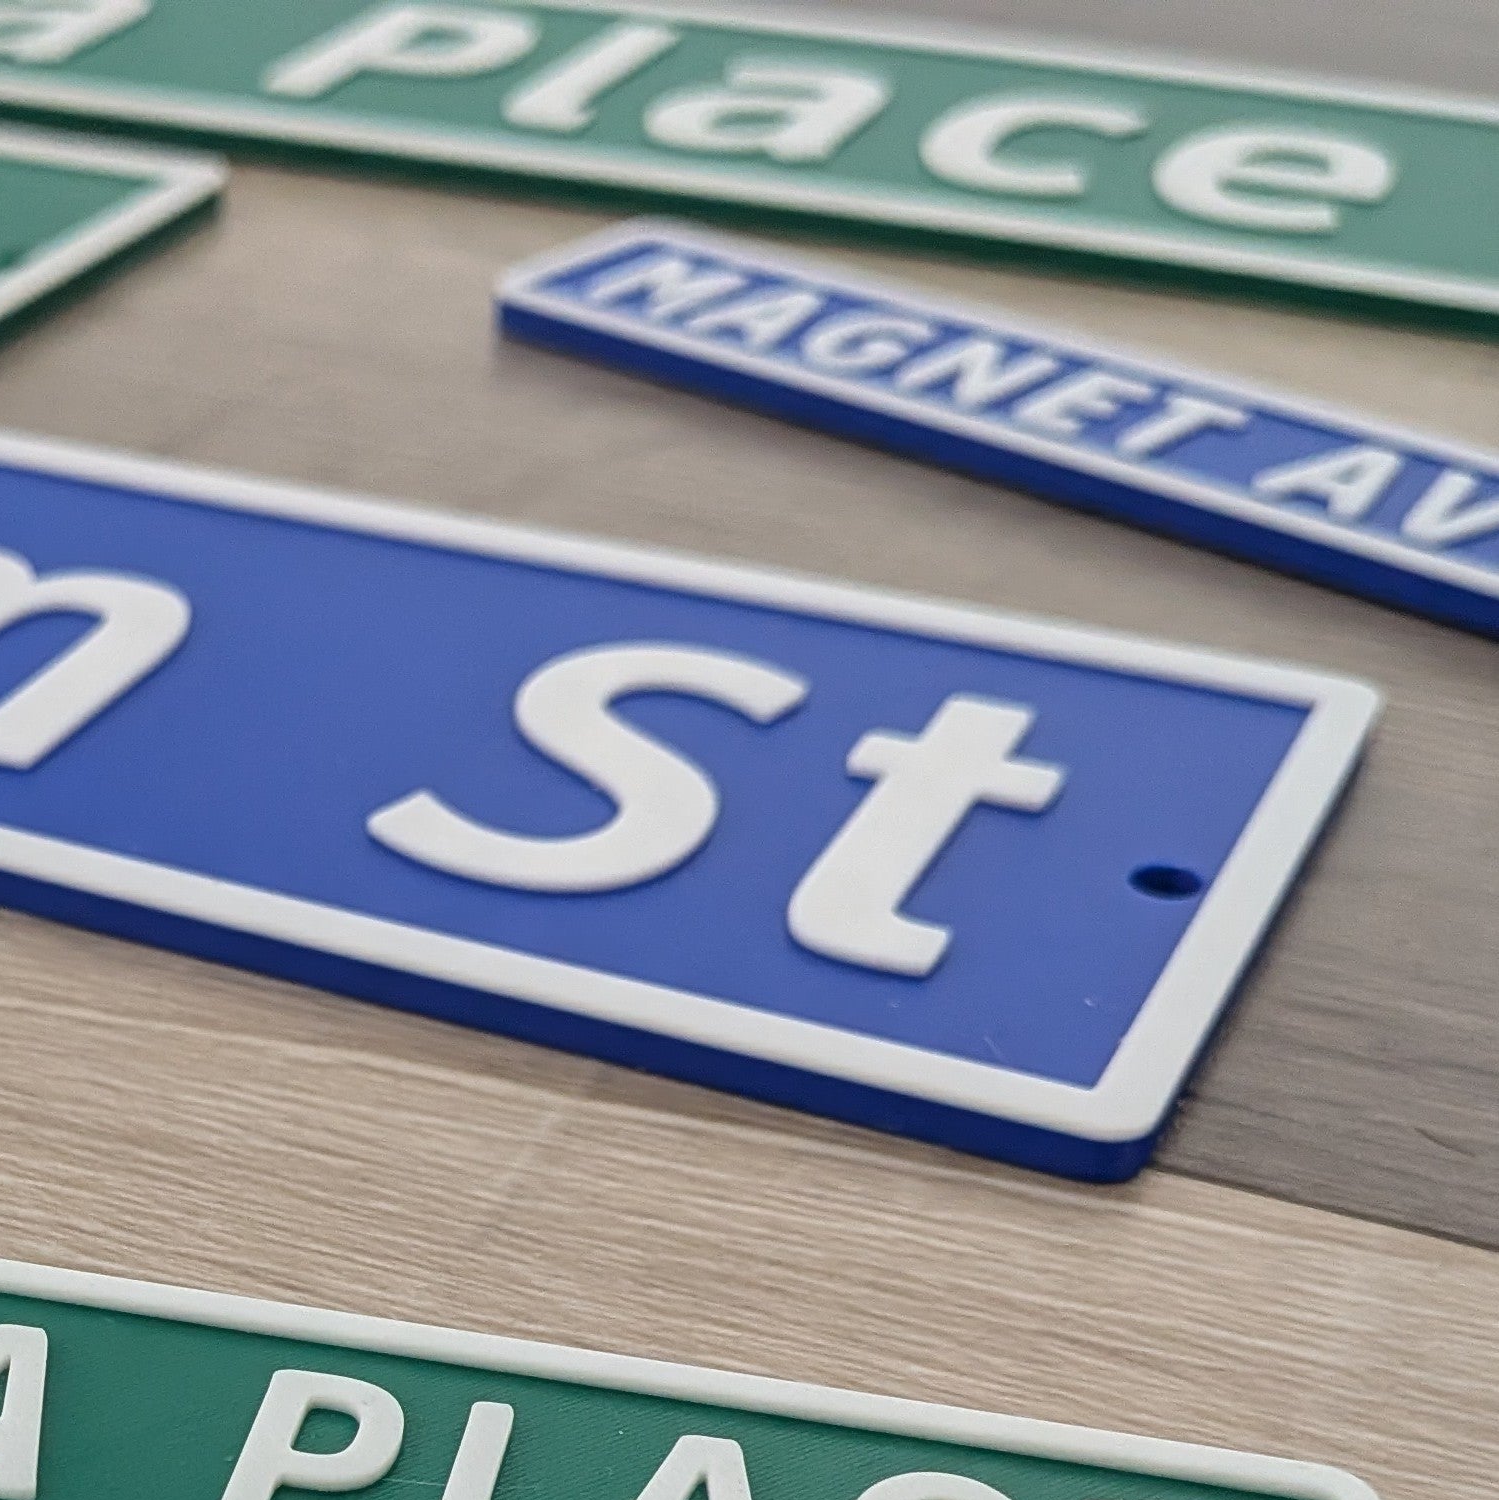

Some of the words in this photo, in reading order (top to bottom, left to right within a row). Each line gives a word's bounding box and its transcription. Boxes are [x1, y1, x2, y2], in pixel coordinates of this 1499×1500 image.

[263, 2, 1397, 234] Place
[590, 252, 1246, 462] MAGNET
[366, 642, 1067, 978] St
